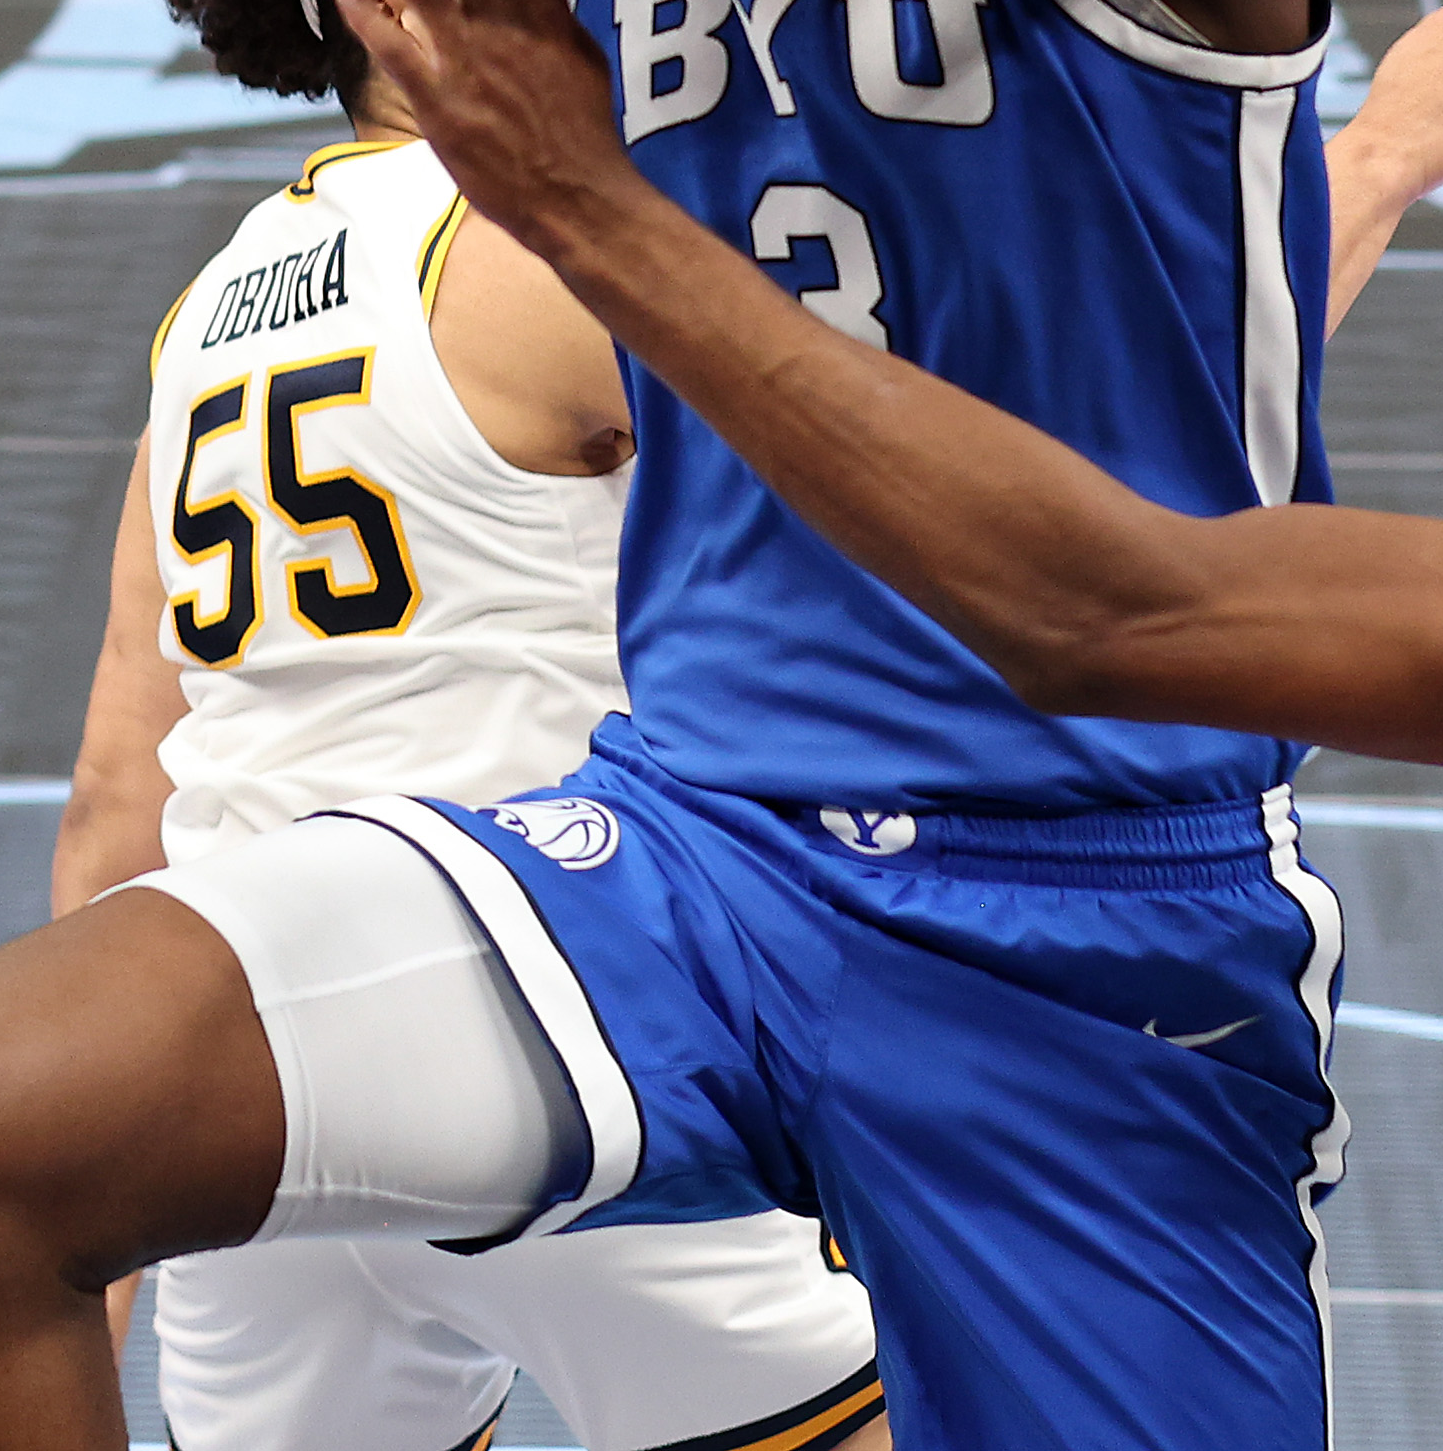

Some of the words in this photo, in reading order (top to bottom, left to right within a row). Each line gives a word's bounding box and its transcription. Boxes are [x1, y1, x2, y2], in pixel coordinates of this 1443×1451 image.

[200, 228, 349, 349] OBIOHA
[750, 183, 890, 352] 3
[168, 345, 423, 671] 55
